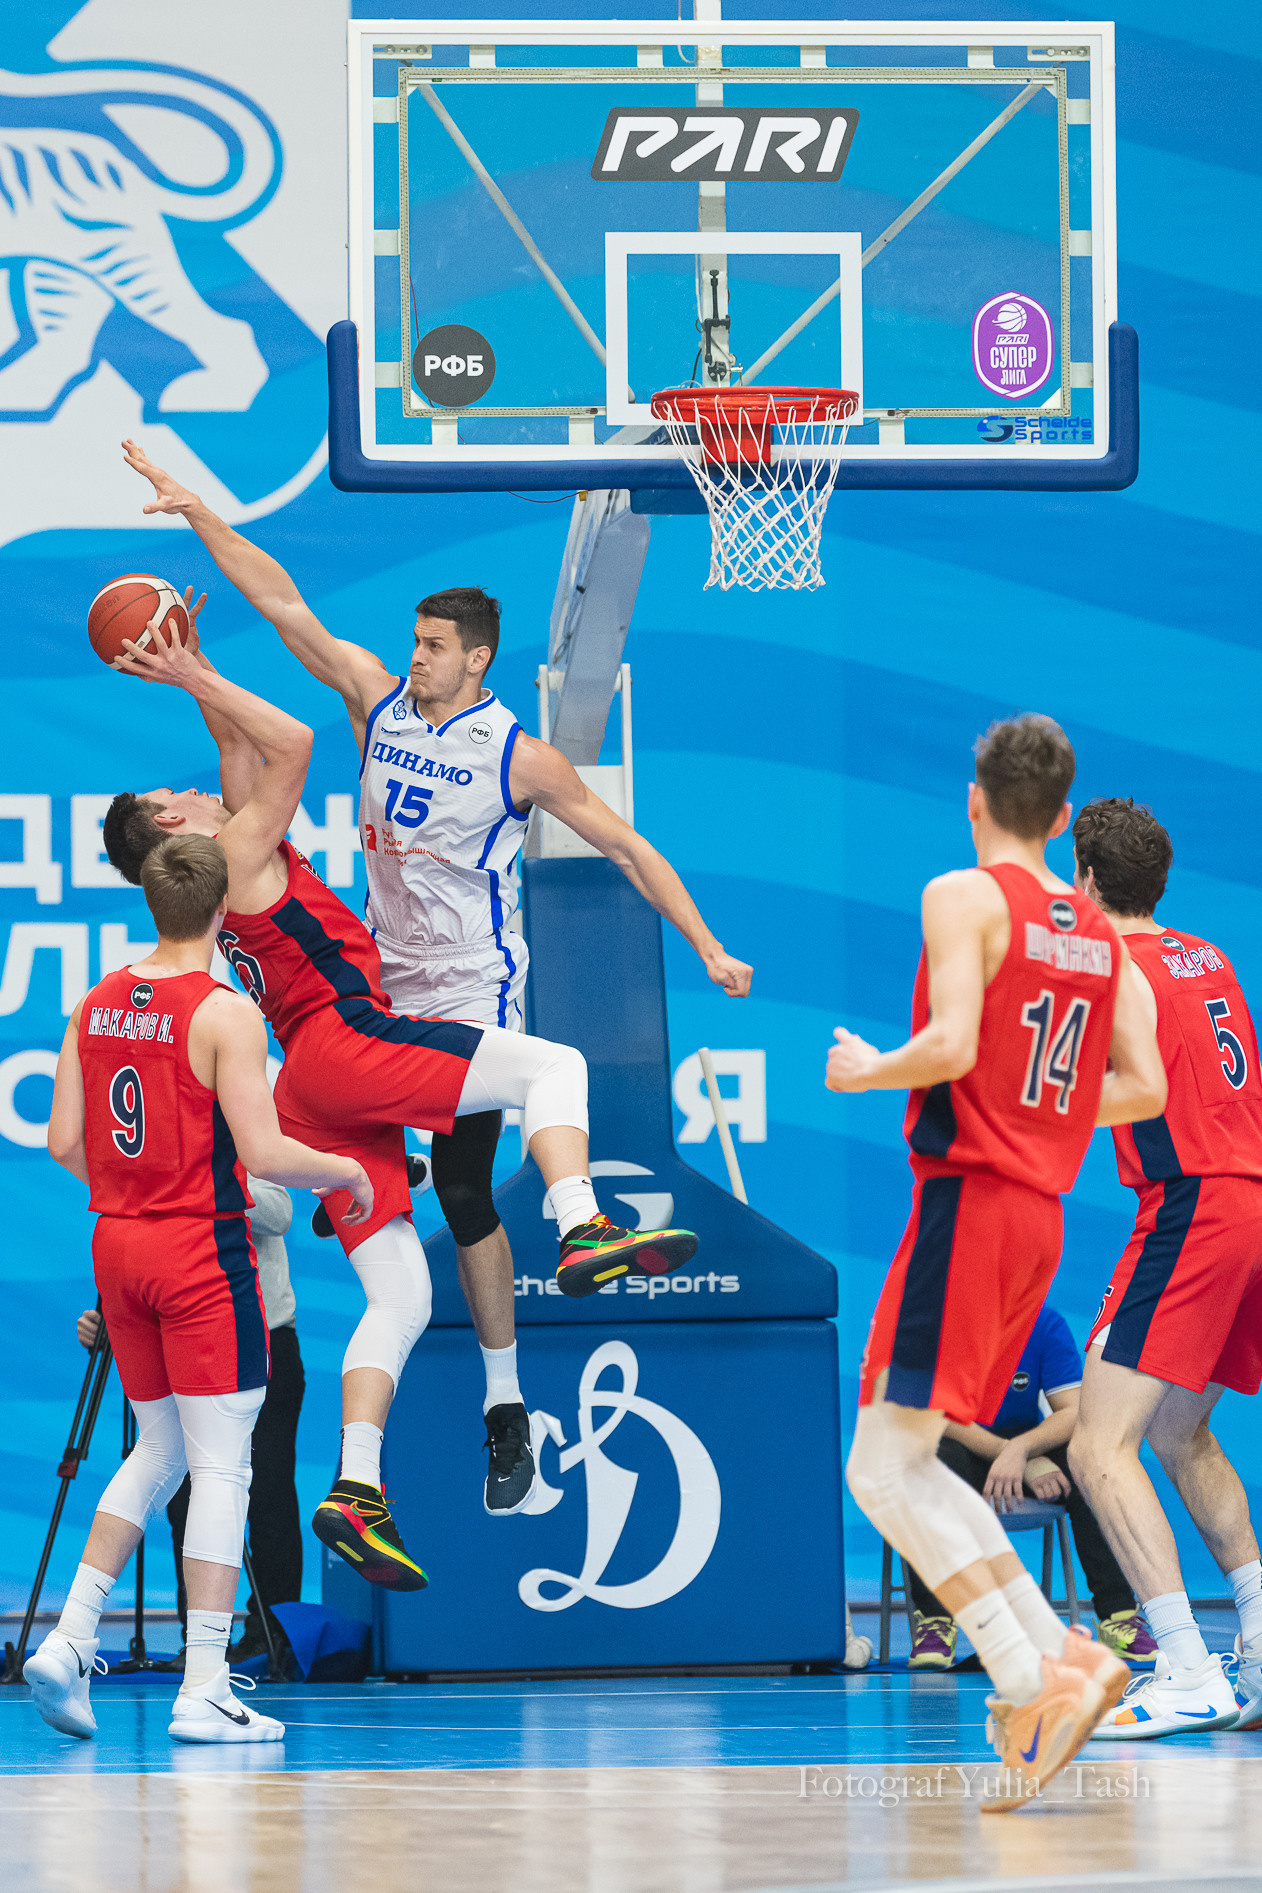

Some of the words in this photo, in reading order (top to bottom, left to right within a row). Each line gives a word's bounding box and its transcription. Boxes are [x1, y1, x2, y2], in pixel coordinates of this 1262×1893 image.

[602, 116, 849, 174] PARI
[424, 355, 484, 377] РФБ
[1000, 369, 1027, 385] ЛИГА
[1014, 428, 1092, 443] Sports
[471, 727, 490, 738] РФБ
[371, 742, 473, 786] ДИНАМО
[385, 778, 434, 828] 15
[88, 1007, 158, 1041] МАКАРОВ
[1204, 997, 1248, 1090] 5
[1020, 988, 1091, 1115] 14
[108, 1065, 145, 1158] 9
[625, 1271, 740, 1300] Sports
